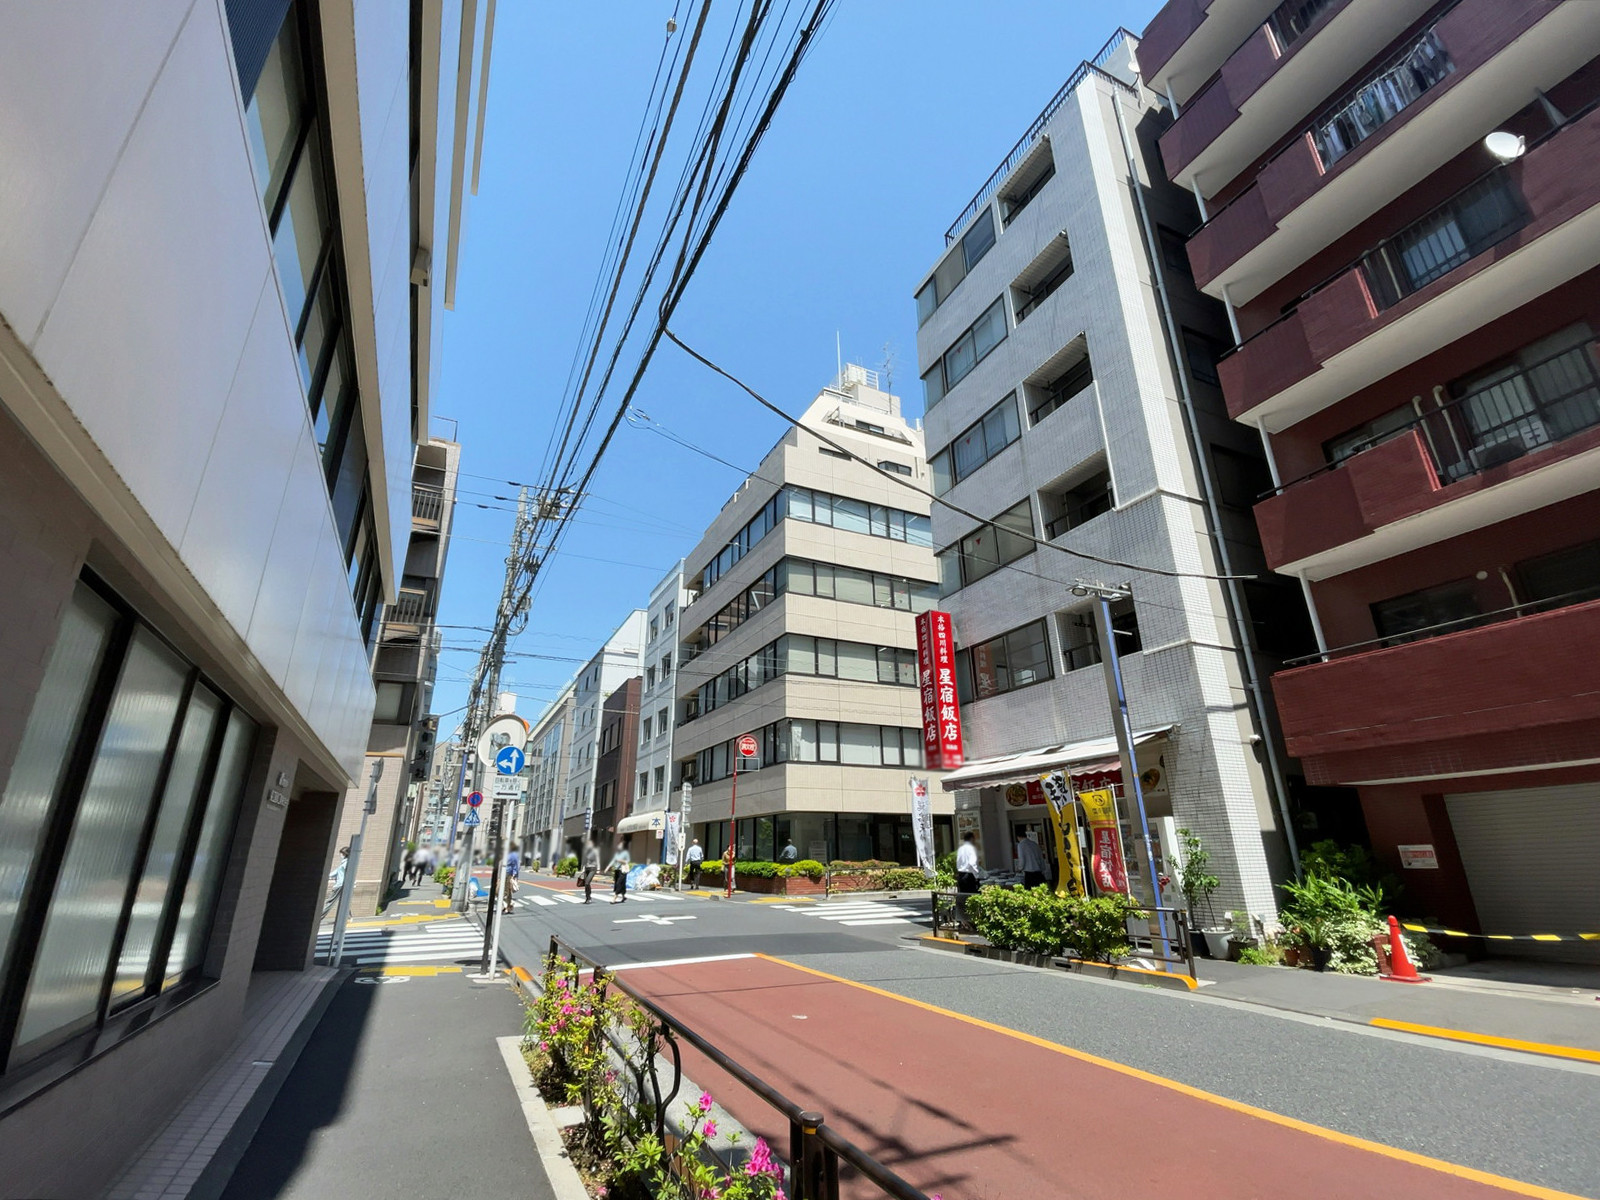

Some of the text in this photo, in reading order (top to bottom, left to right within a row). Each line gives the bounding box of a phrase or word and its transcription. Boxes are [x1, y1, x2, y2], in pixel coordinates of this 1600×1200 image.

[937, 614, 949, 664] 本格四川料理
[921, 669, 937, 743] 星宿飯店
[939, 667, 958, 741] 星宿飯店
